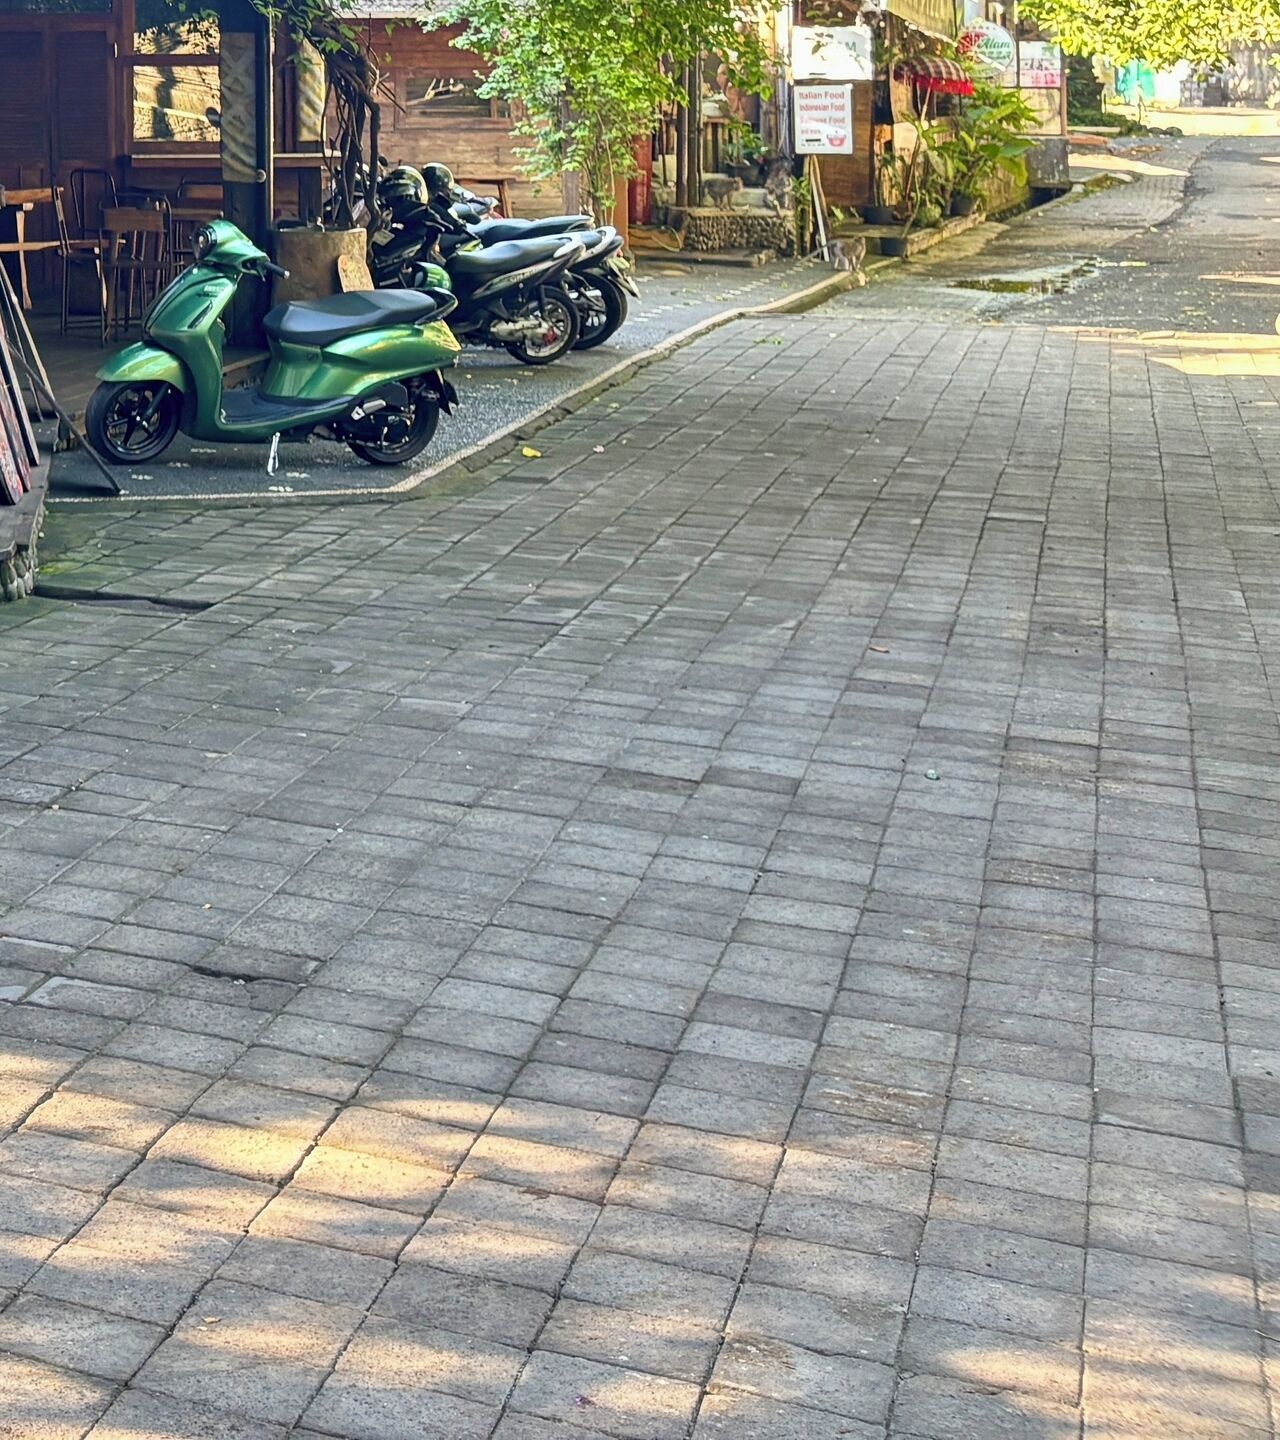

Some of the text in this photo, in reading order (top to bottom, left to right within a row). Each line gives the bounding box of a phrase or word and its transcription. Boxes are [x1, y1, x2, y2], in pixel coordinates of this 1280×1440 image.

[799, 91, 845, 100] Italian Food
[799, 102, 845, 111] Indonesian Food
[829, 116, 845, 124] Food
